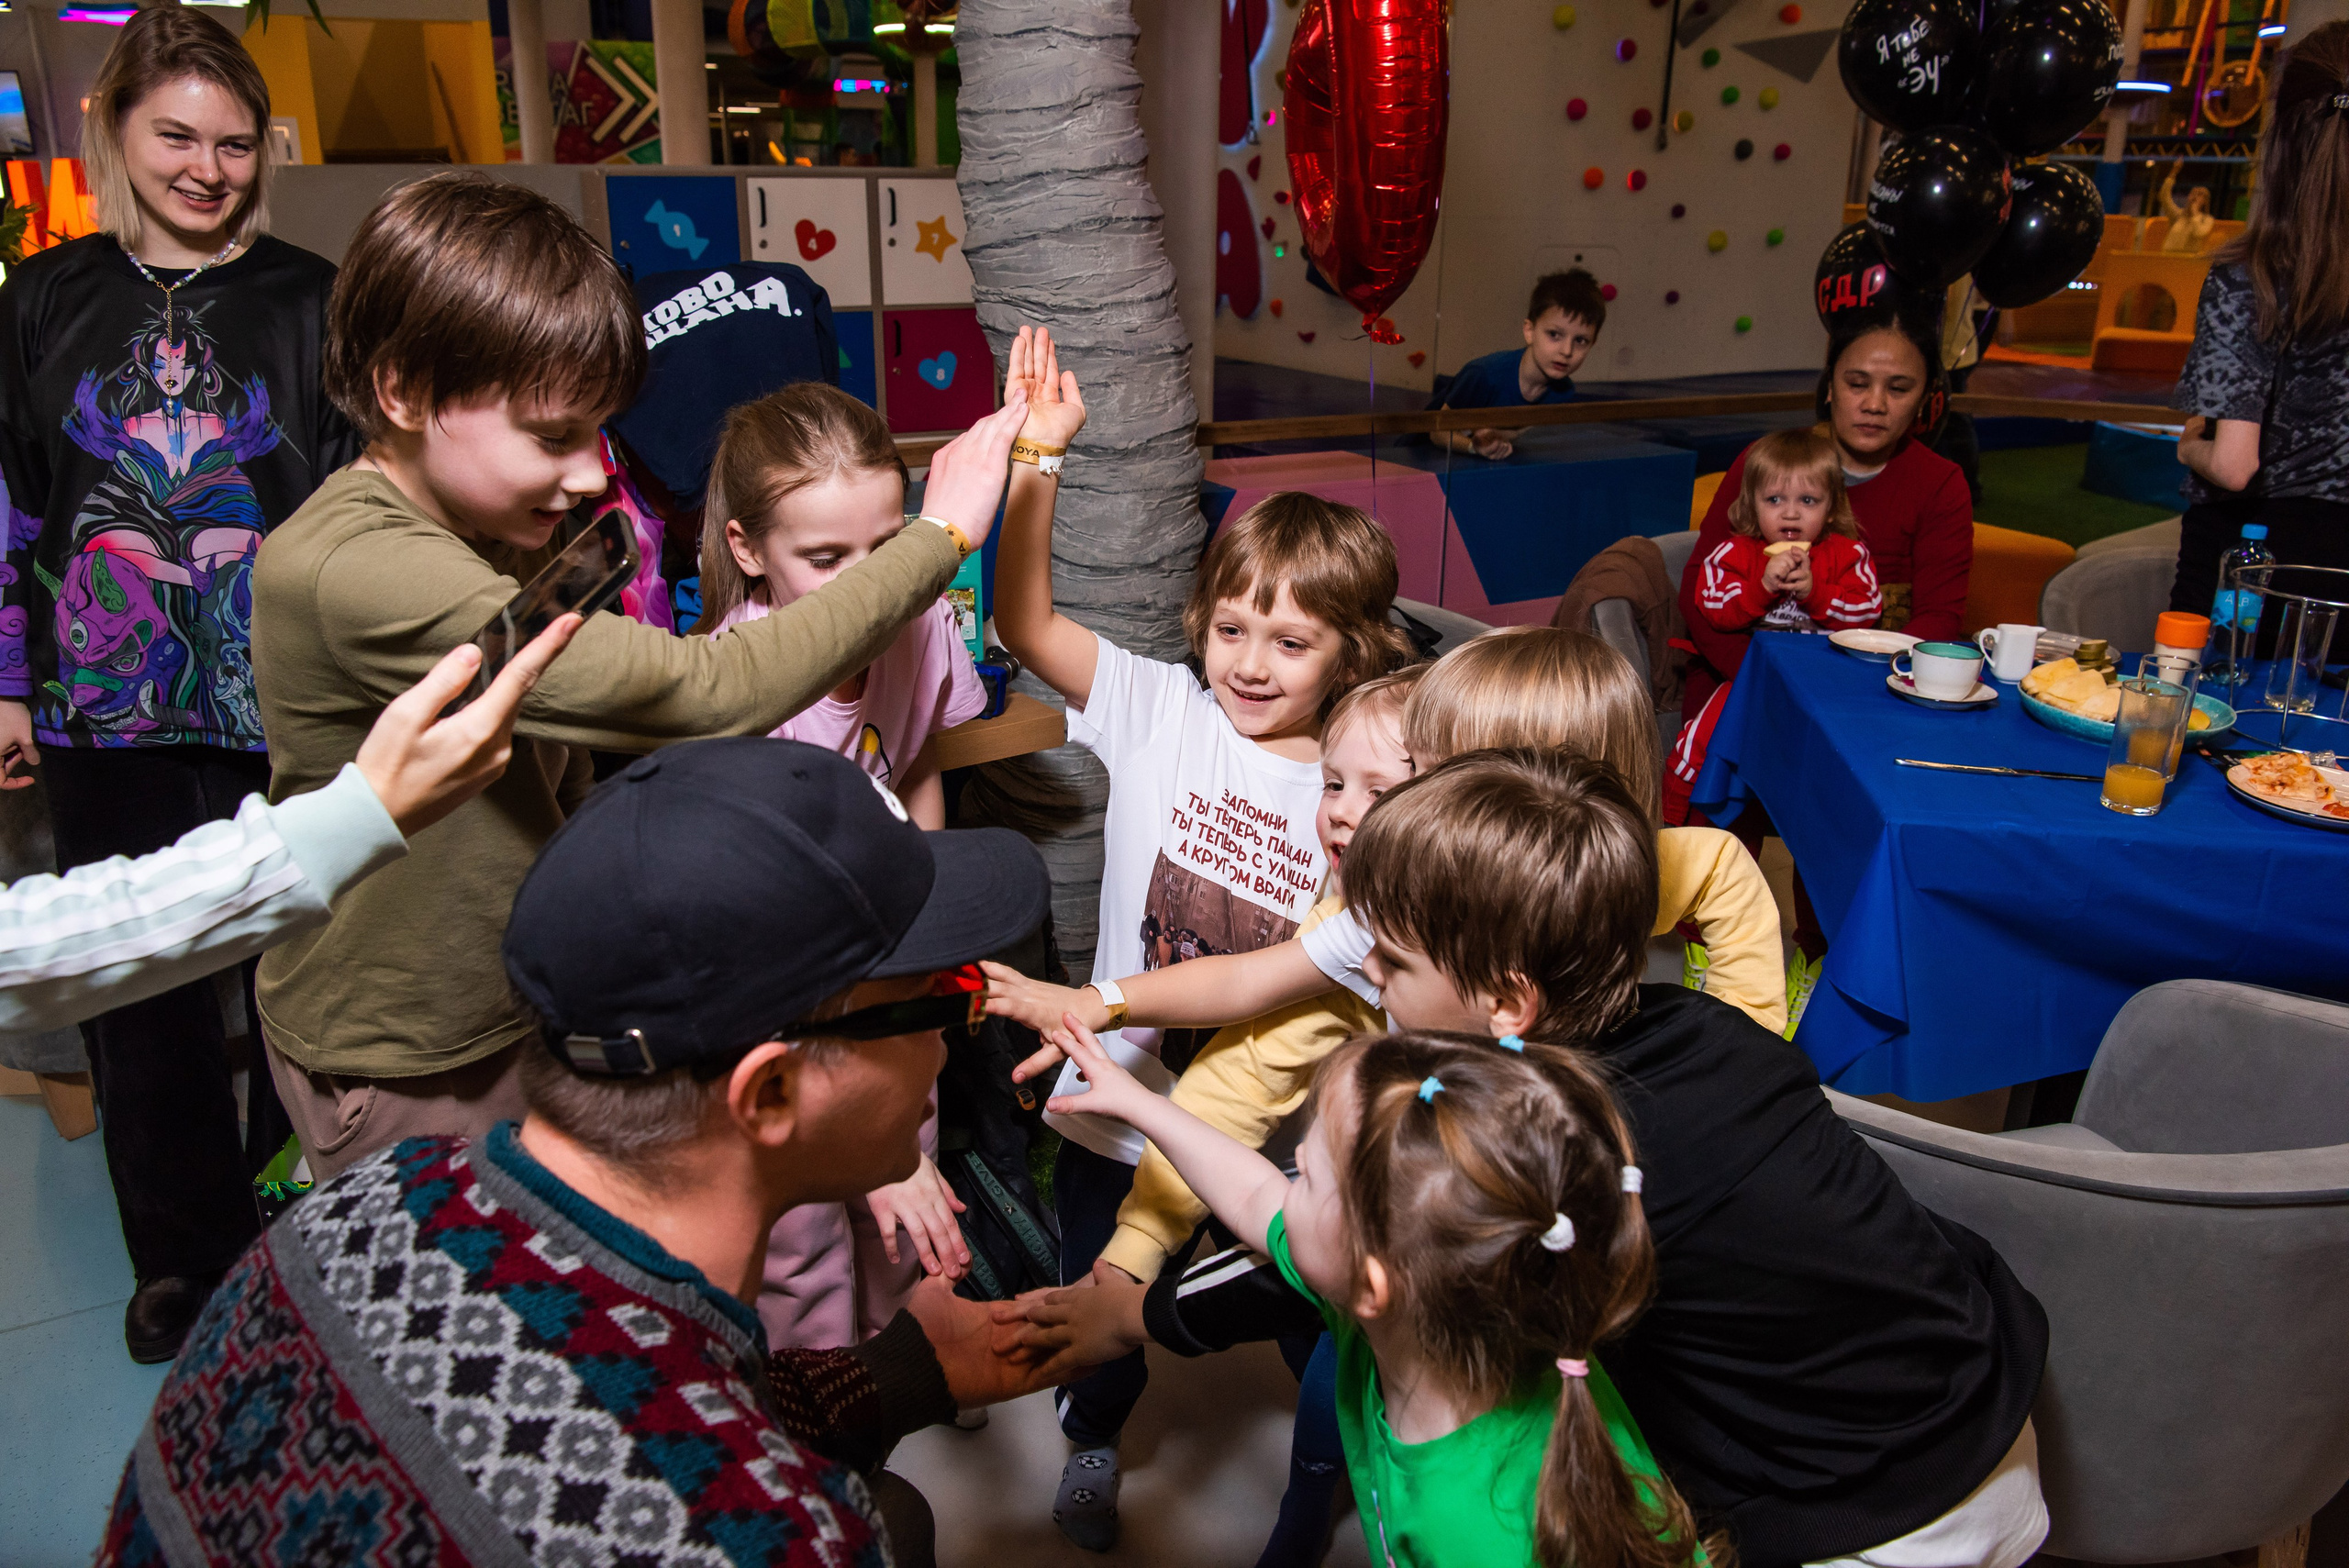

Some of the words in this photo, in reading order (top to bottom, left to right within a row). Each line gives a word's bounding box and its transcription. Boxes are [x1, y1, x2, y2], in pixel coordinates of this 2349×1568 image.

[1876, 34, 1890, 65] Я
[1902, 47, 1920, 68] НЕ
[807, 238, 818, 250] 4
[936, 368, 945, 381] 8
[1188, 791, 1210, 817] ТЫ
[1214, 806, 1263, 847] ТЕПЕРЬ
[1267, 835, 1313, 868] ПАЦАН
[1221, 788, 1288, 833] ЗАПОМНИ
[1171, 806, 1194, 832] ТЫ
[1252, 852, 1263, 869] С
[1178, 839, 1188, 857] А
[1190, 844, 1251, 888] КРУГОМ
